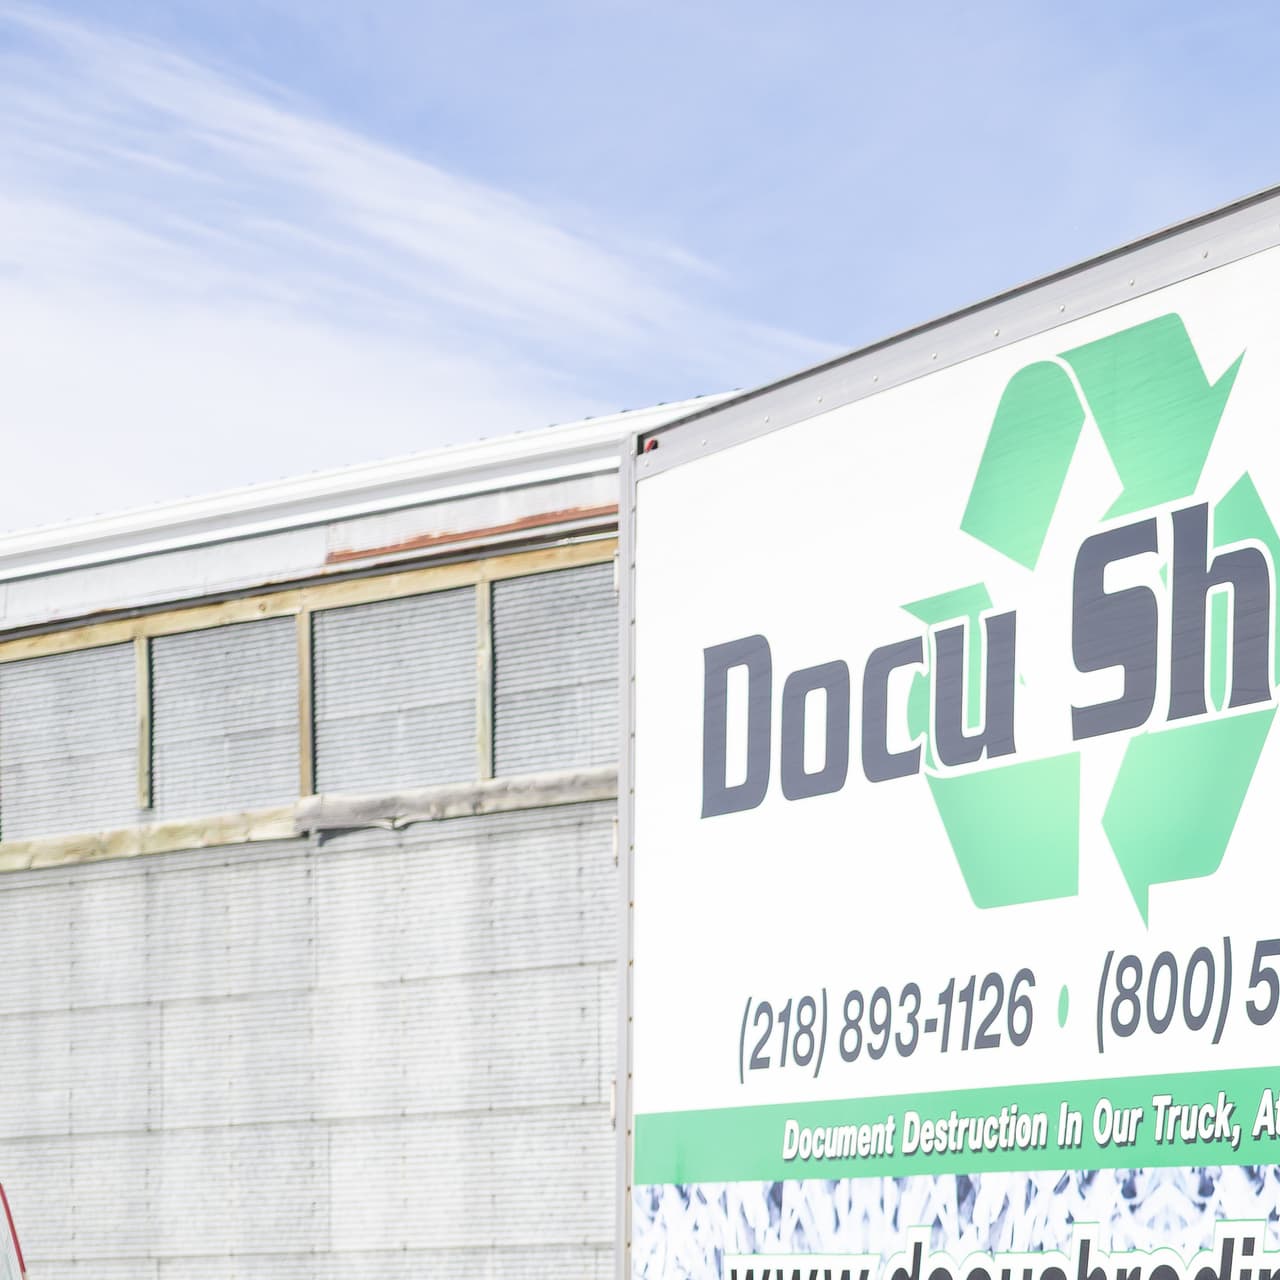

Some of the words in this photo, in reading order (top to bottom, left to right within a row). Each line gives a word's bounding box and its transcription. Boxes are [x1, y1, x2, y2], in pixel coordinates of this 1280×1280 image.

[740, 987, 826, 1084] (218)
[839, 967, 1036, 1063] 893-1126
[1096, 936, 1231, 1053] (800)
[782, 1114, 894, 1163] Document
[901, 1103, 1047, 1155] Destruction
[1057, 1102, 1081, 1148] In
[1092, 1099, 1142, 1146] Our
[1153, 1091, 1240, 1152] Truck,
